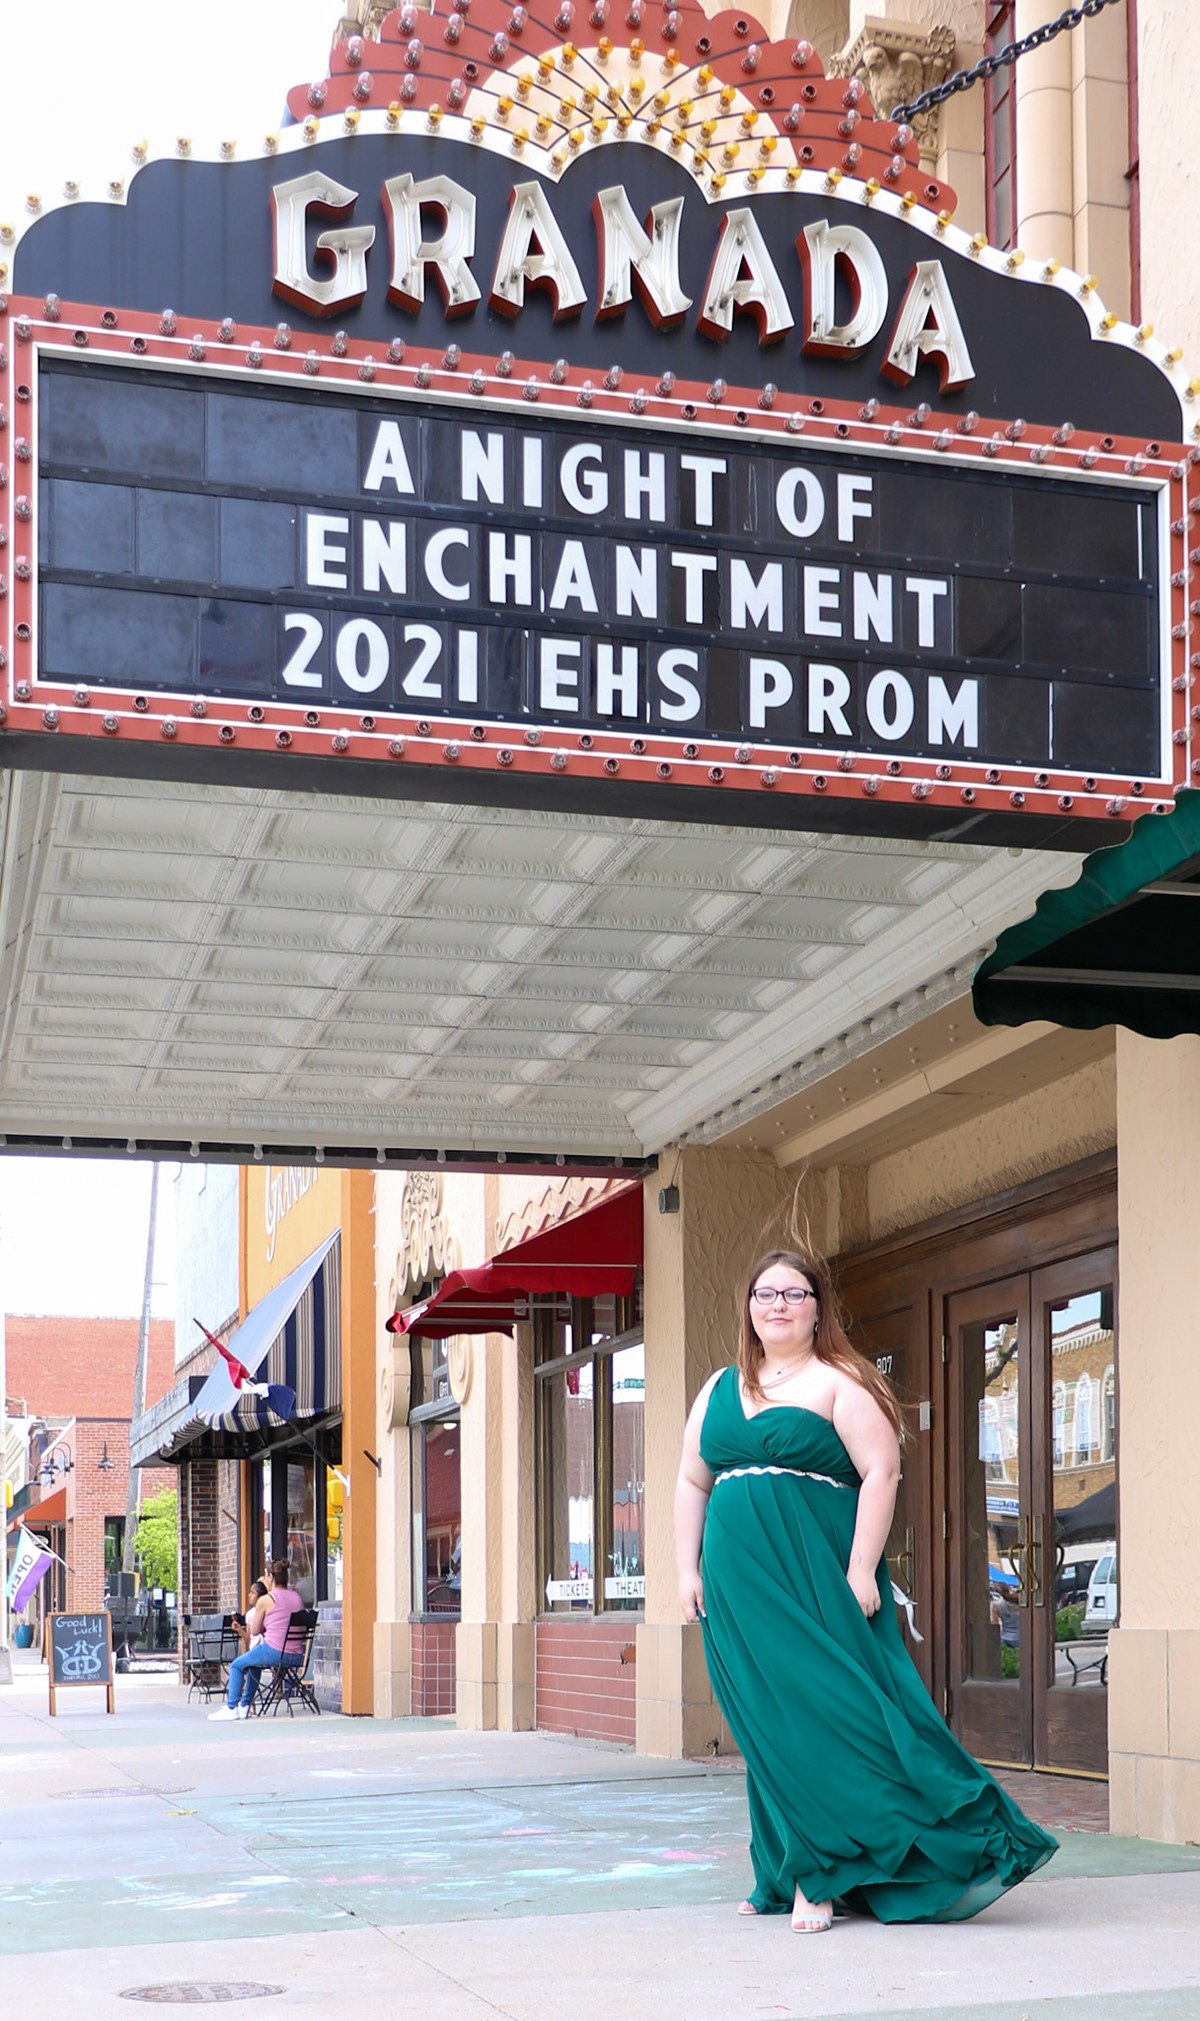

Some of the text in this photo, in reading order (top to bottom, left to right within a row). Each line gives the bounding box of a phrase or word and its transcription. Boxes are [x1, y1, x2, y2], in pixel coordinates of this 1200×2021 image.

[272, 171, 977, 392] GRANADA
[363, 420, 873, 542] A NIGHT OF
[306, 513, 948, 648] ENCHANTMENT
[281, 612, 979, 748] 2021 EHS PROM
[55, 1615, 87, 1628] Good
[73, 1618, 102, 1638] Luck!
[560, 1581, 645, 1597] TICKETS THEAT
